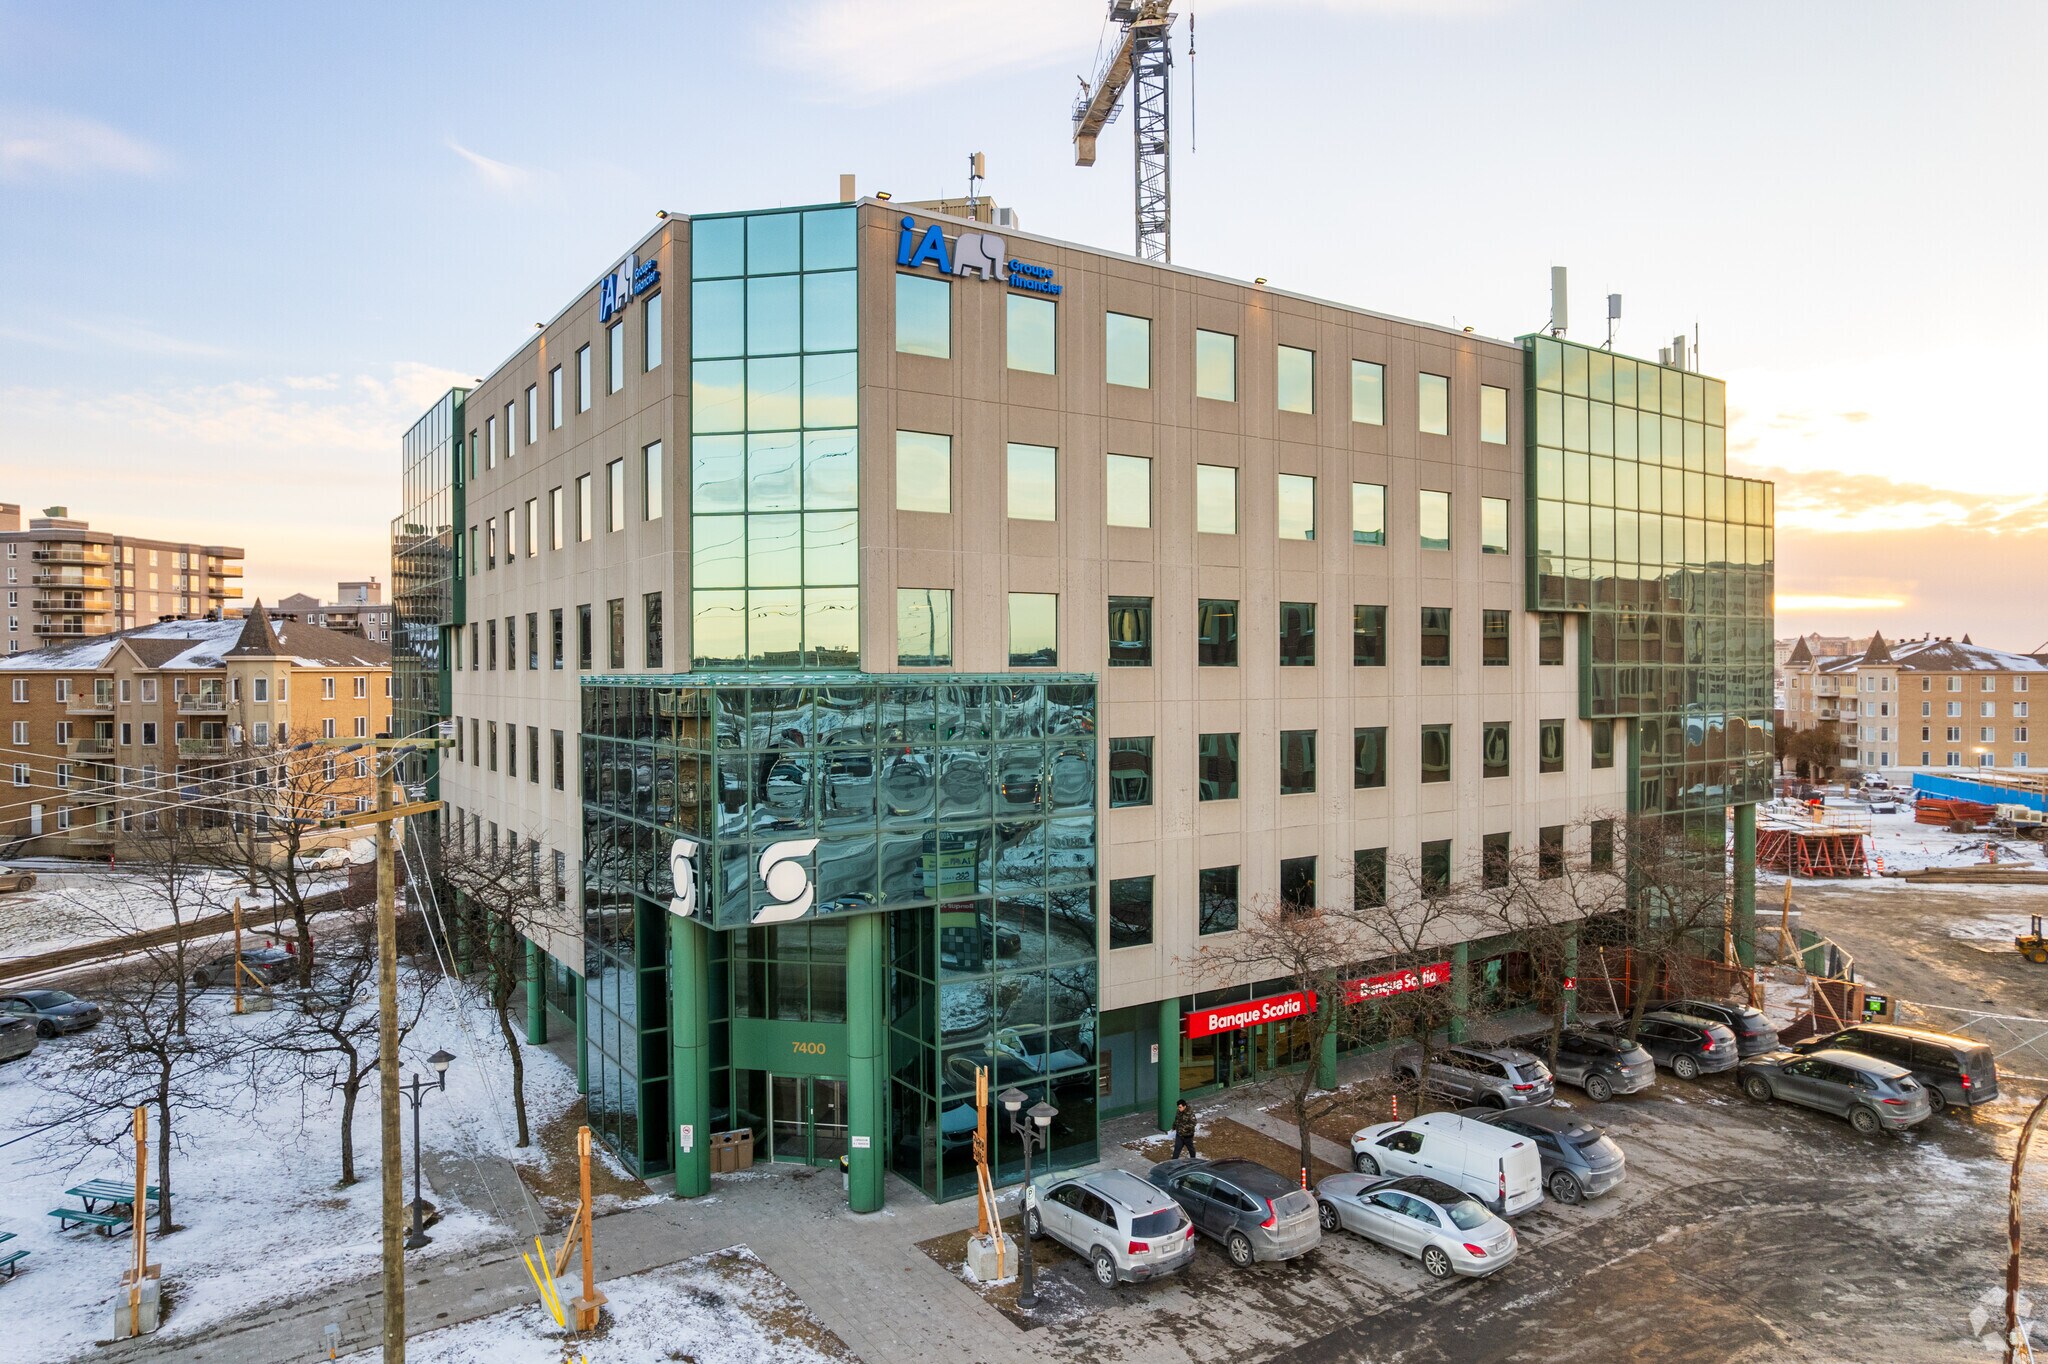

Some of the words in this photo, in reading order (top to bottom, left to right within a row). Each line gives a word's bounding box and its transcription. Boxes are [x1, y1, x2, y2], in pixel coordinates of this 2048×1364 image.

[1008, 259, 1054, 279] Groupe
[1009, 273, 1063, 296] financier
[1208, 1009, 1260, 1031] Banque
[1261, 998, 1301, 1019] Scotia
[792, 1041, 826, 1055] 7400
